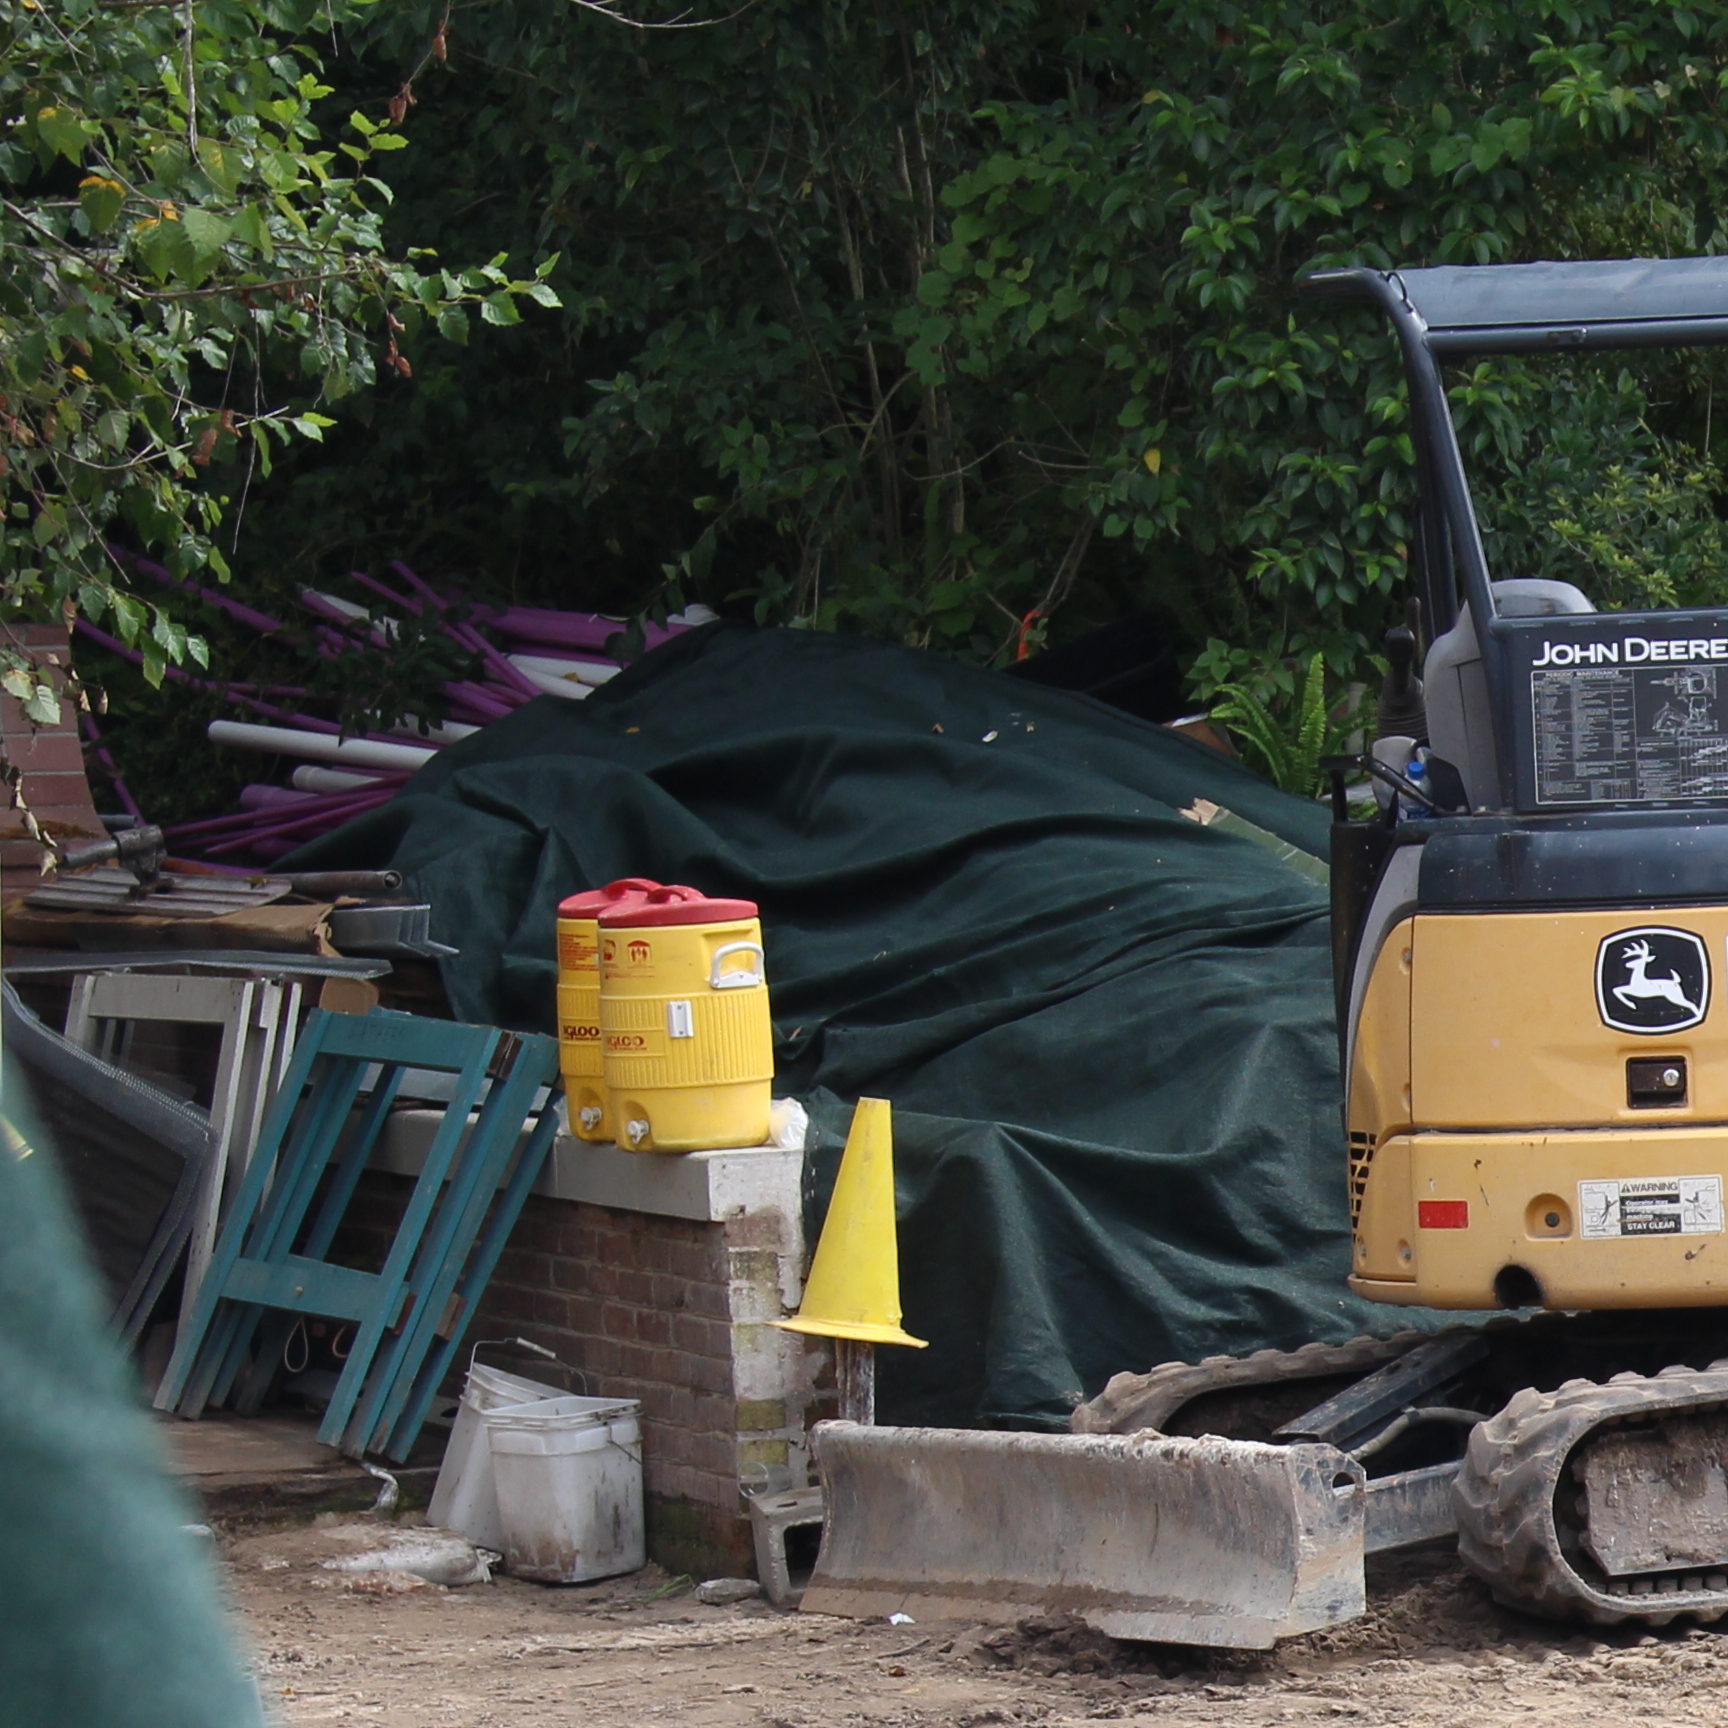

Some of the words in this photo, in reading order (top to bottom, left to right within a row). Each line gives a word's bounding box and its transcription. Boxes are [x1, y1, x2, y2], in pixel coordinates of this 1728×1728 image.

[1532, 640, 1619, 666] JOHN
[563, 1024, 600, 1041] IGLOO
[1631, 1181, 1678, 1194] WARNING
[1627, 1221, 1648, 1231] STAY
[1648, 1219, 1676, 1230] CLEAR
